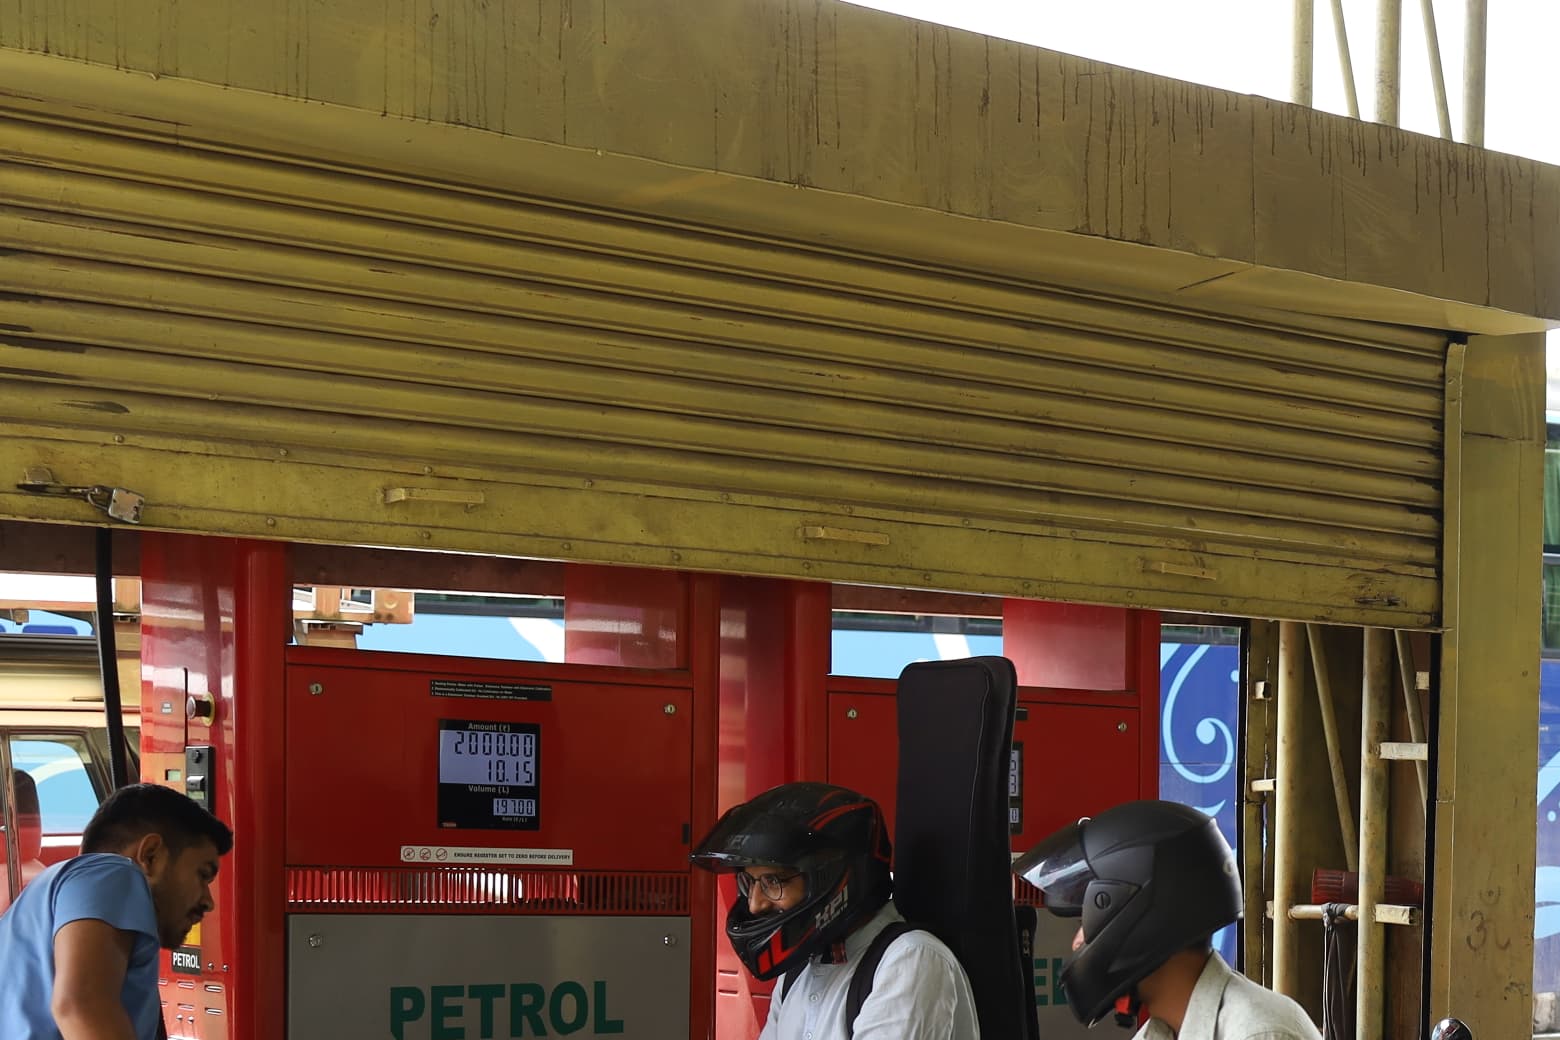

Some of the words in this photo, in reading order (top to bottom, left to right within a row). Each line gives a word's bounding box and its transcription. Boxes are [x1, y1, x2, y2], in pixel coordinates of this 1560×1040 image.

[468, 723, 497, 732] Amount
[455, 731, 533, 758] 2000.00
[488, 759, 533, 784] 10.15
[468, 785, 496, 793] Volume
[173, 952, 200, 969] PETROL
